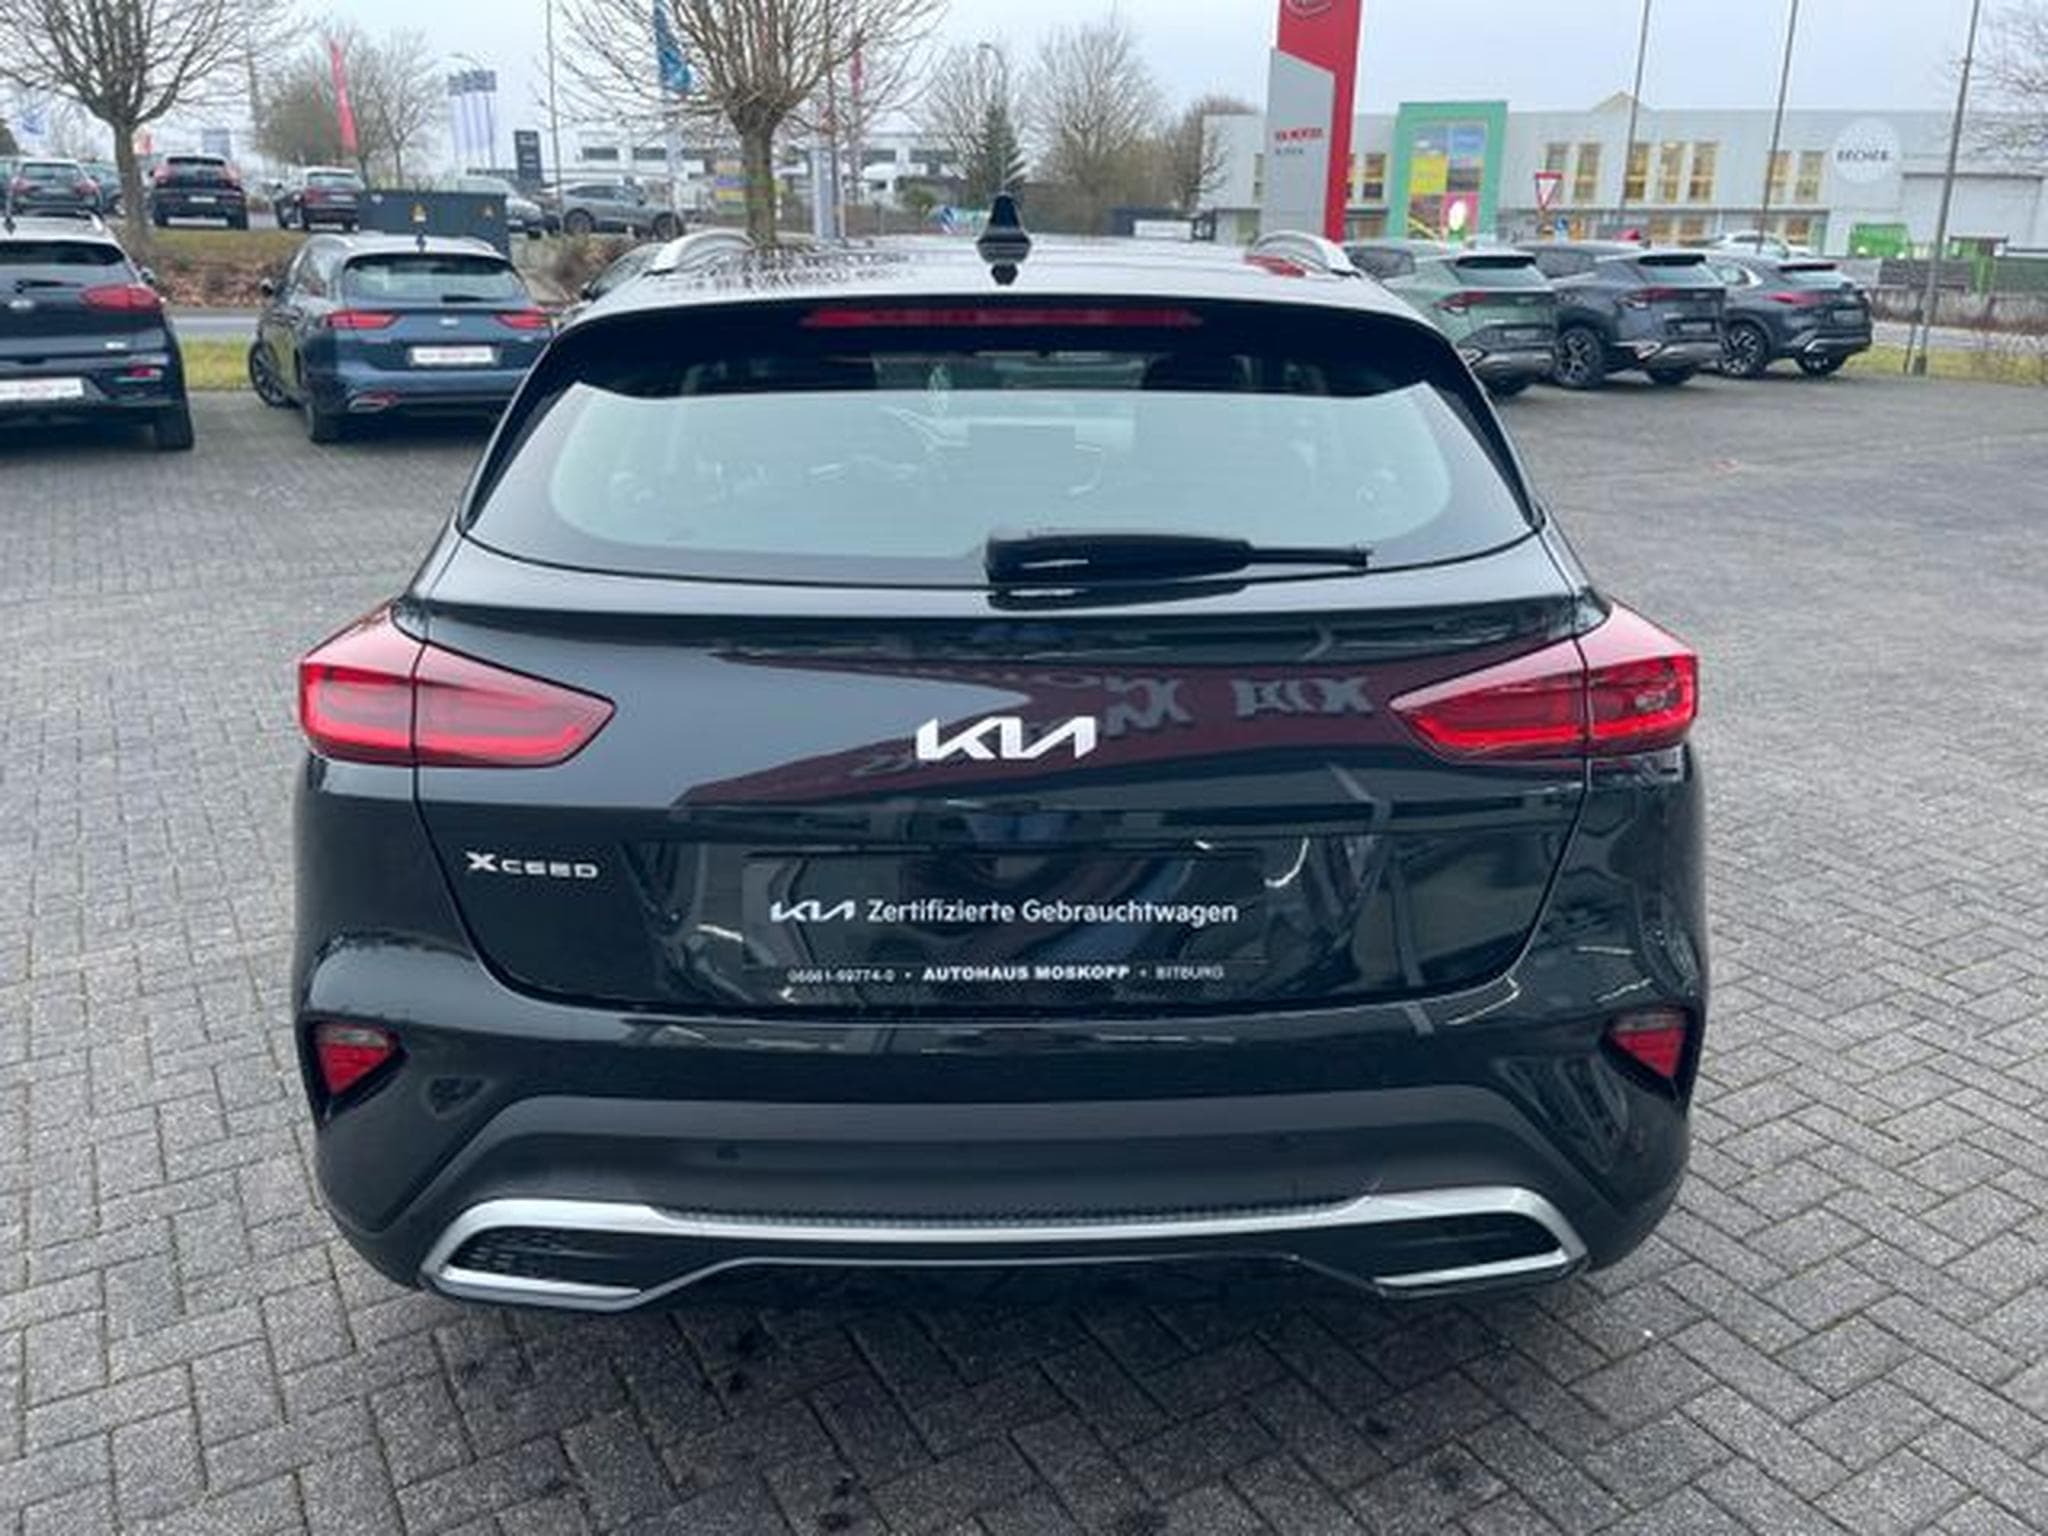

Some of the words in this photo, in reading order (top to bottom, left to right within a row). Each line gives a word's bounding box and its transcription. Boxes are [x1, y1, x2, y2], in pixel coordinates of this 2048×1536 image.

[916, 716, 1096, 760] KIA
[465, 851, 599, 878] XCEED
[770, 900, 856, 922] KIA
[867, 899, 1015, 922] Zertifizierte
[1022, 899, 1239, 928] Gebrauchtwagen
[922, 966, 1029, 981] AUTOHAUS
[1034, 965, 1130, 980] MOSKOPP
